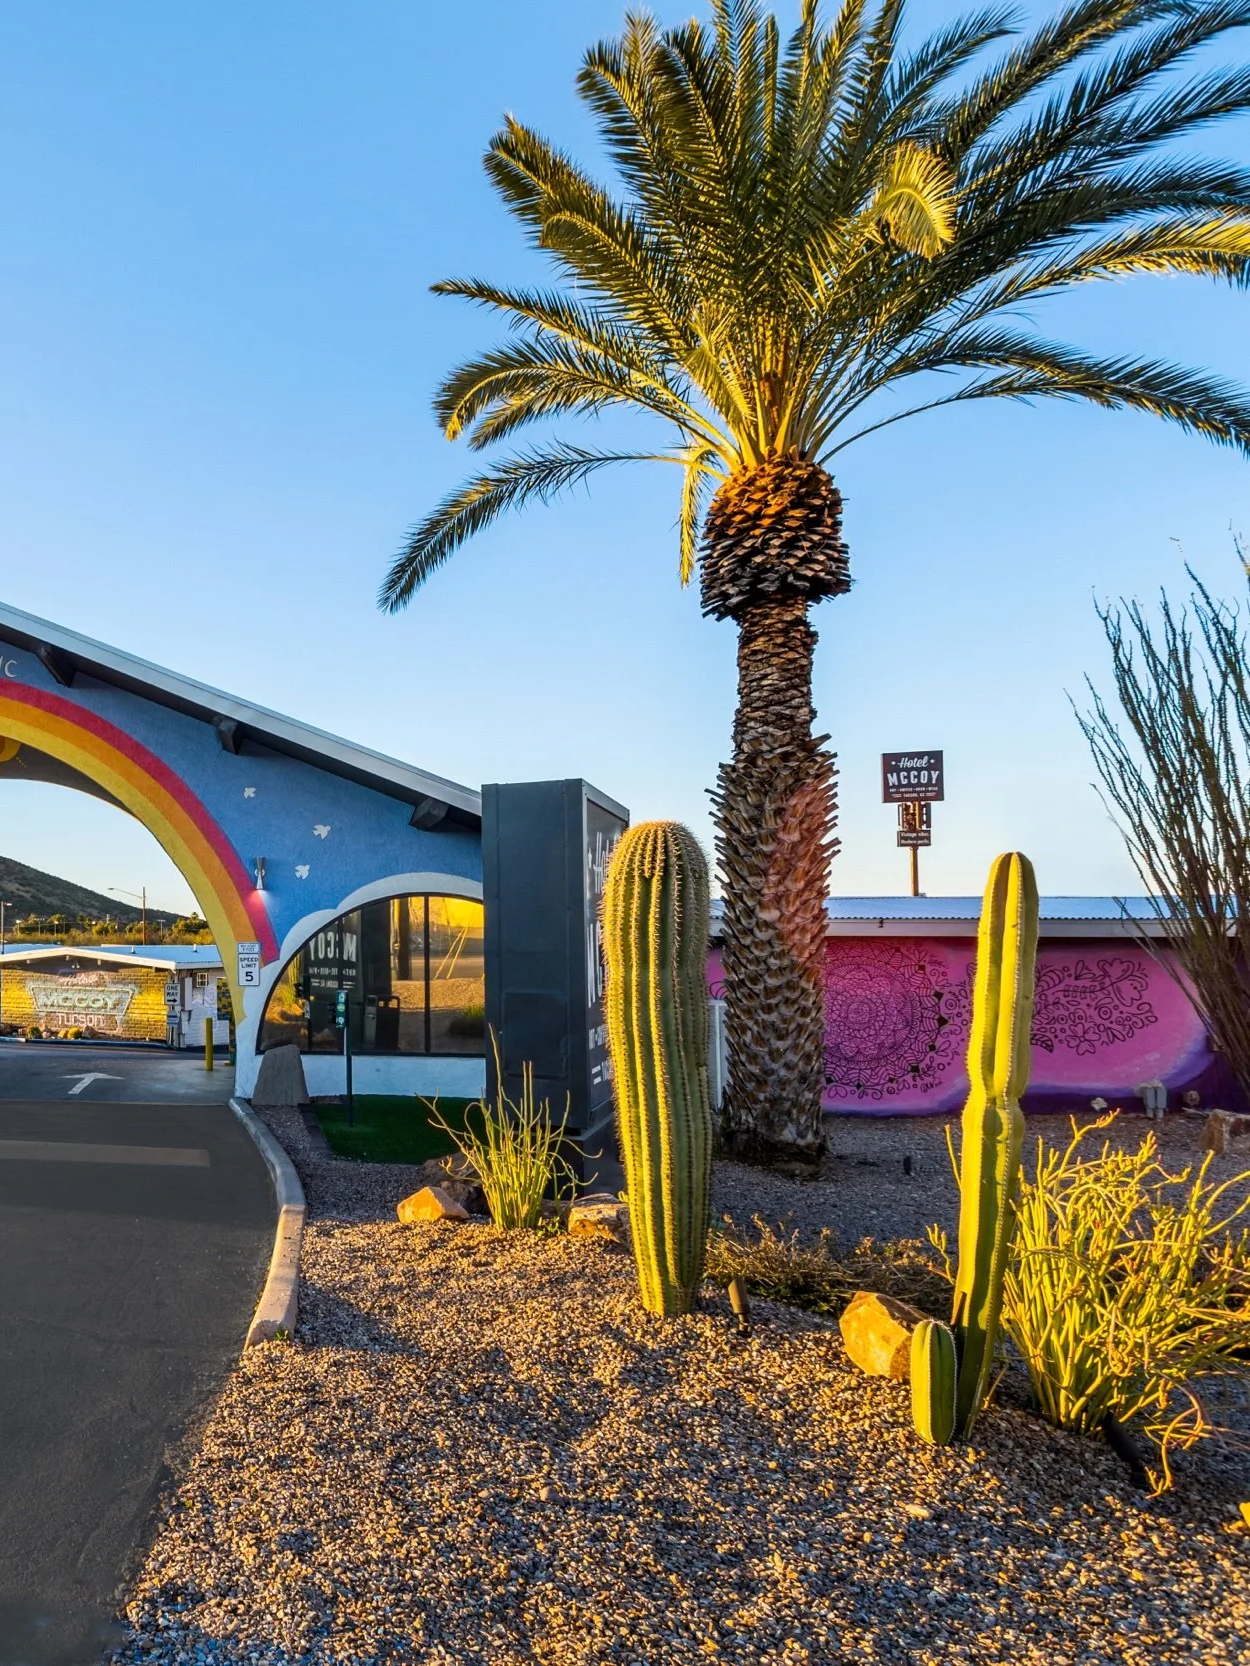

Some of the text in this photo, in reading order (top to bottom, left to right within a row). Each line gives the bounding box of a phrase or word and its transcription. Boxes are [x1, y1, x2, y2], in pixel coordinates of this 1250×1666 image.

[897, 756, 929, 768] Hotel
[886, 770, 940, 786] MCCOY
[245, 971, 254, 982] 5
